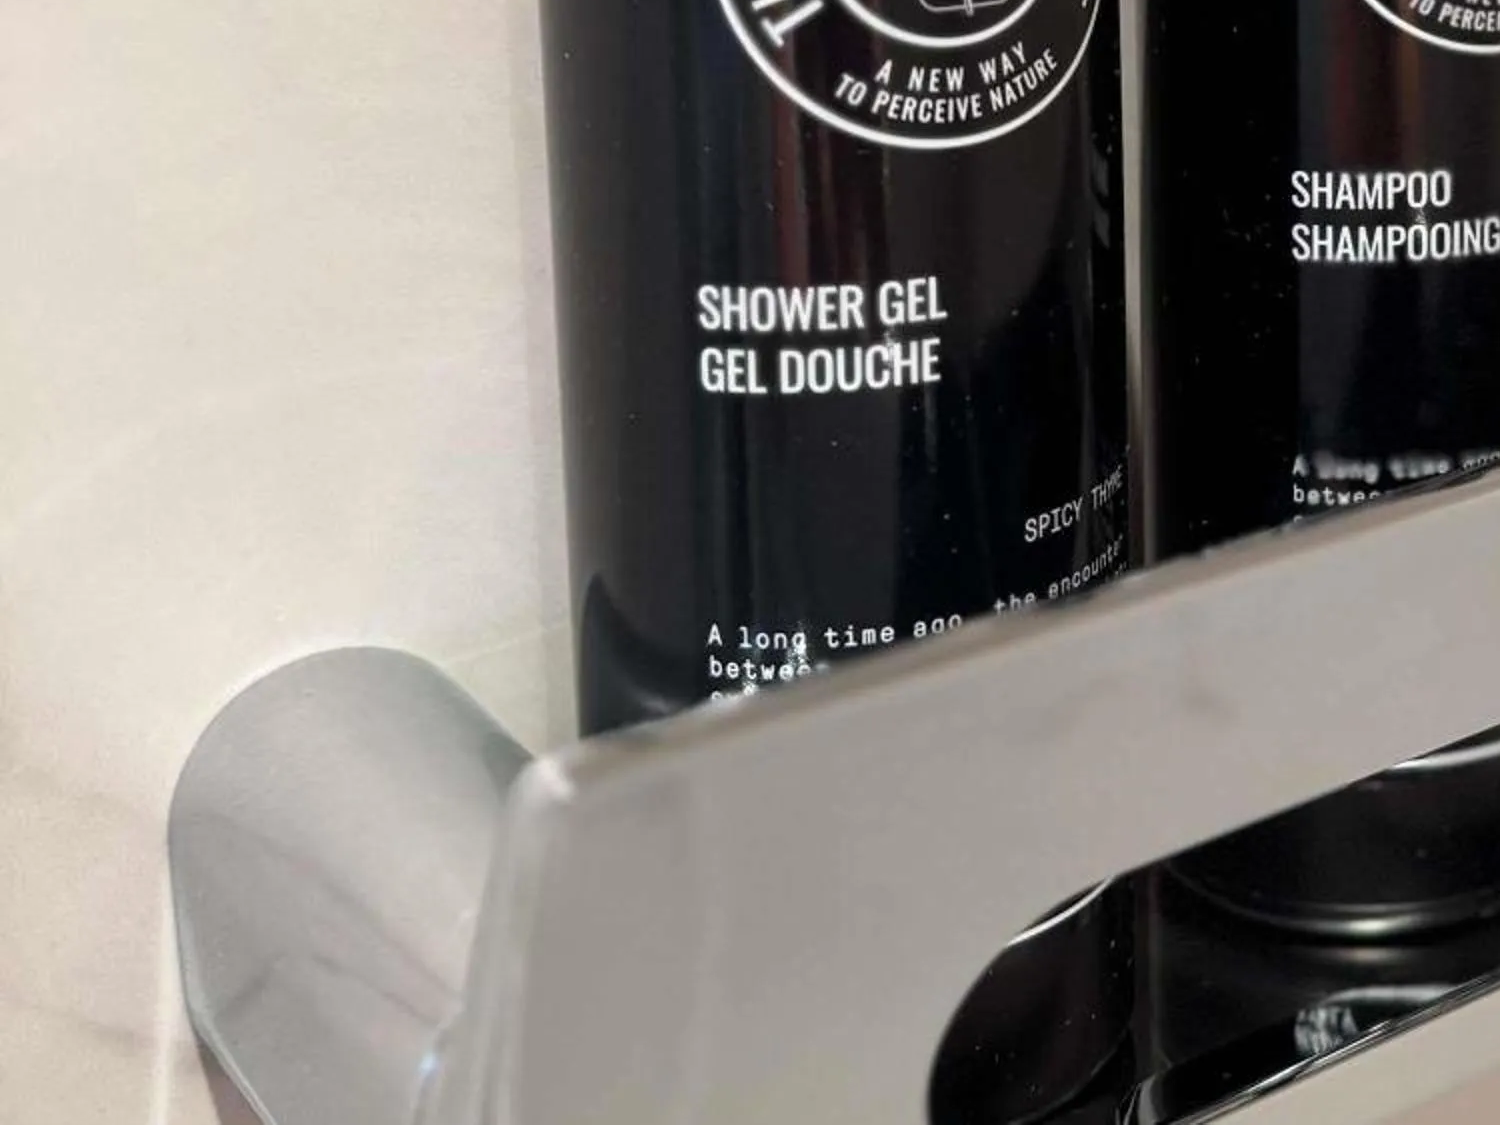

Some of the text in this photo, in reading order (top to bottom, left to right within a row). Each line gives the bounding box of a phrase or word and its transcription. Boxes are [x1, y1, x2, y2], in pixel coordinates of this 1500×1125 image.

[834, 48, 1058, 124] TO PERCEIVE NATURE
[874, 40, 1027, 92] A NEW WAY
[1291, 170, 1452, 210] SHAMPOO
[698, 276, 948, 332] SHOWER GEL
[700, 338, 942, 394] GEL DOUCHE
[1024, 496, 1083, 543] SPICY
[707, 623, 723, 647] A
[739, 626, 807, 653] long
[824, 625, 895, 648] time
